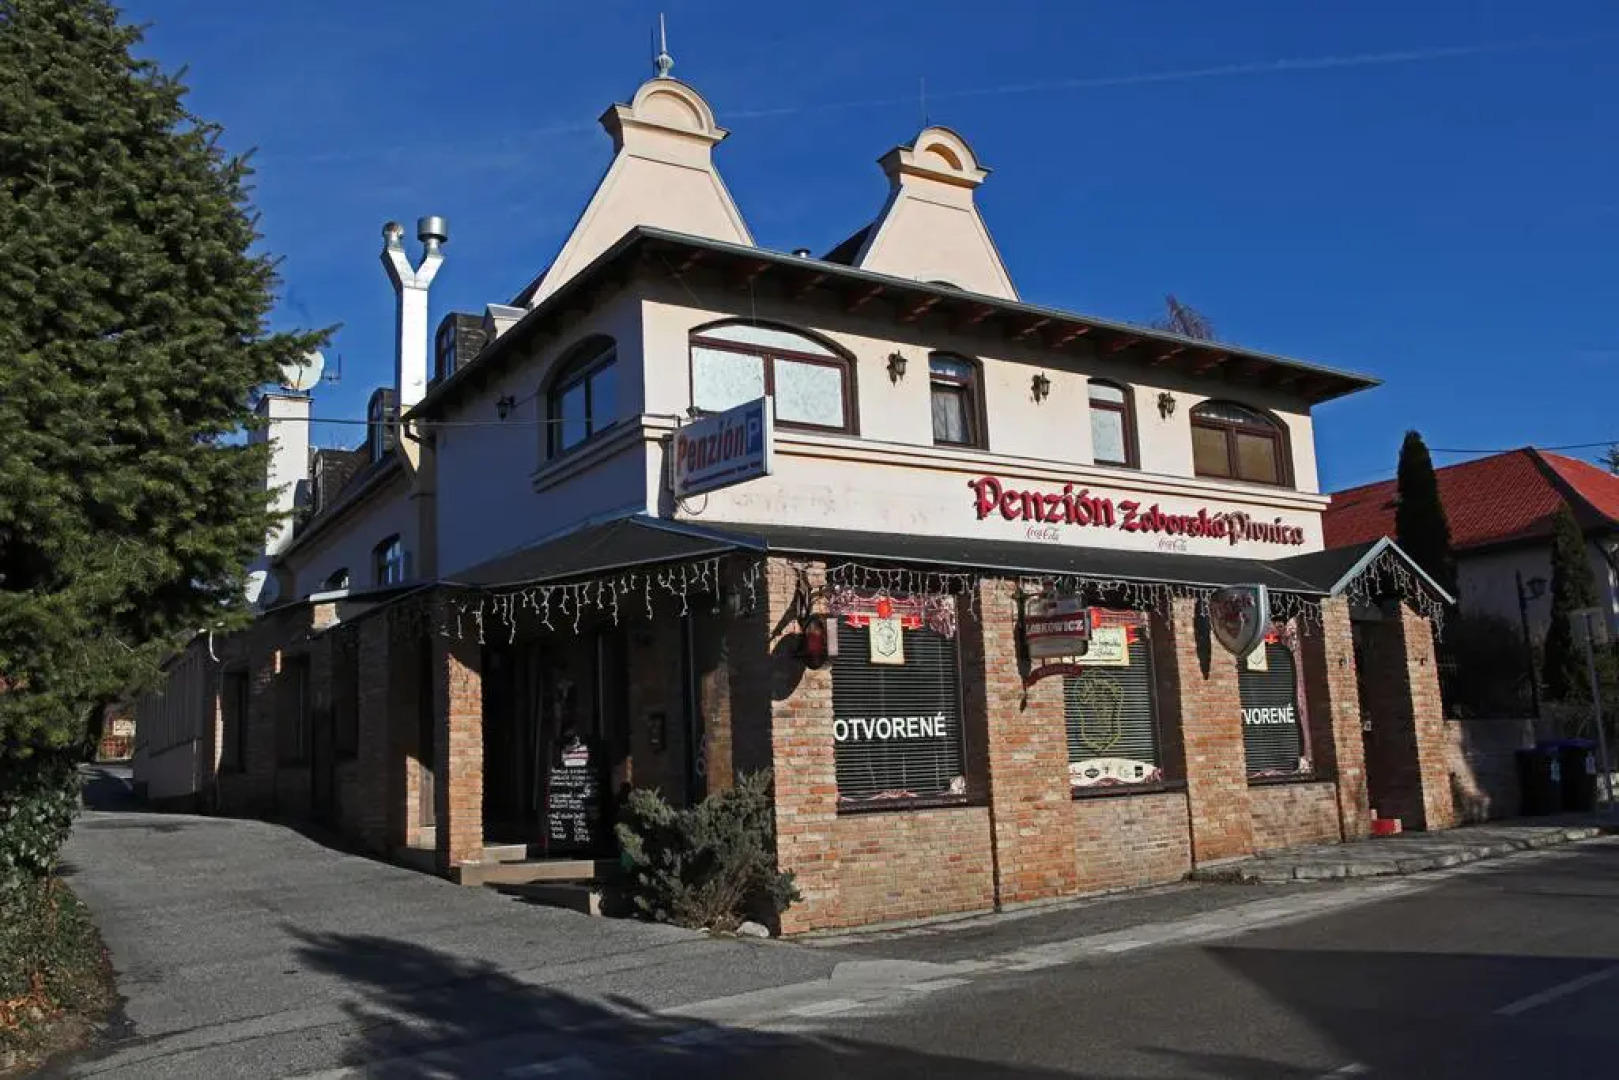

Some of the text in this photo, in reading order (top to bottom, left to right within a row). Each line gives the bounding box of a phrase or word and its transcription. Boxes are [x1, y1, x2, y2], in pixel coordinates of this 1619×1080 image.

[677, 416, 744, 473] Penzión
[967, 475, 1116, 527] Penzión
[833, 711, 947, 740] OTVORENÉ
[1241, 703, 1296, 725] VORENÉ
